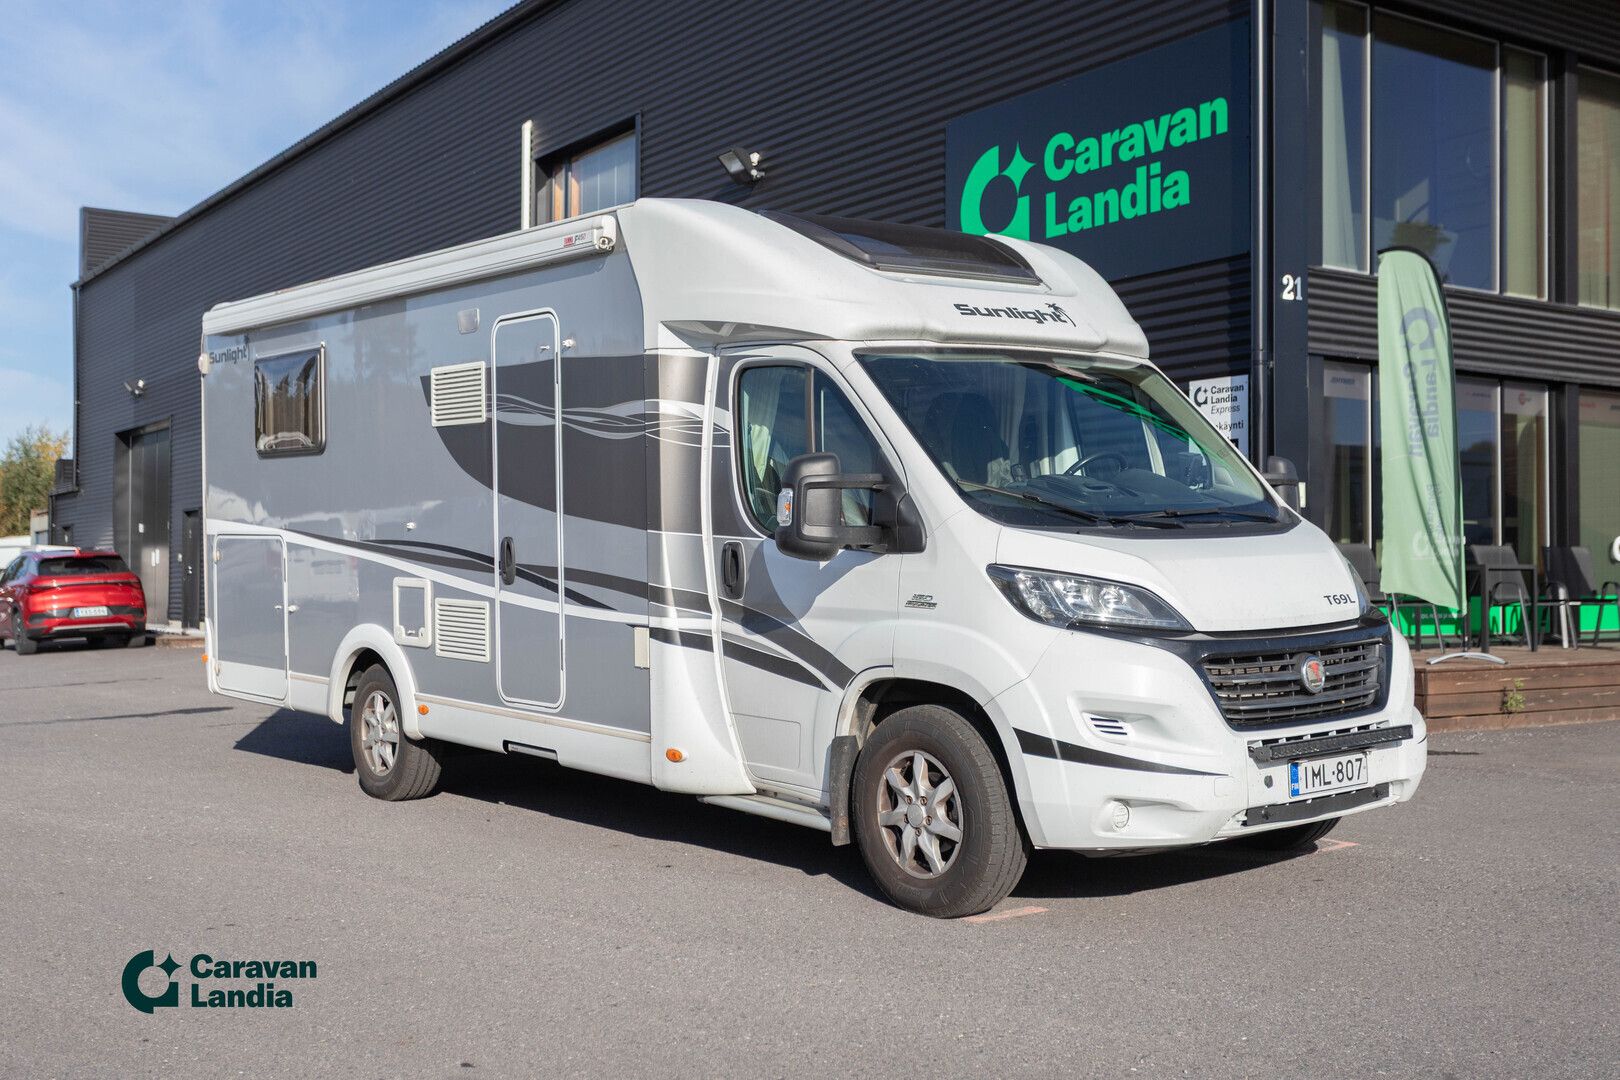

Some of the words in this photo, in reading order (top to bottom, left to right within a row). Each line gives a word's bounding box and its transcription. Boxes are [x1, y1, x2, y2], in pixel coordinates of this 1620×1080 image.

[1043, 97, 1229, 181] Caravan
[1045, 161, 1191, 239] Landia
[1282, 274, 1303, 300] 21
[953, 303, 1070, 324] Sunlight
[208, 343, 248, 364] Sunlight
[1210, 384, 1244, 395] Caravan
[1210, 394, 1238, 405] Landia
[1210, 404, 1241, 415] Express
[1216, 420, 1244, 432] käynti
[1323, 594, 1356, 605] T69L
[1304, 758, 1363, 789] IML-807
